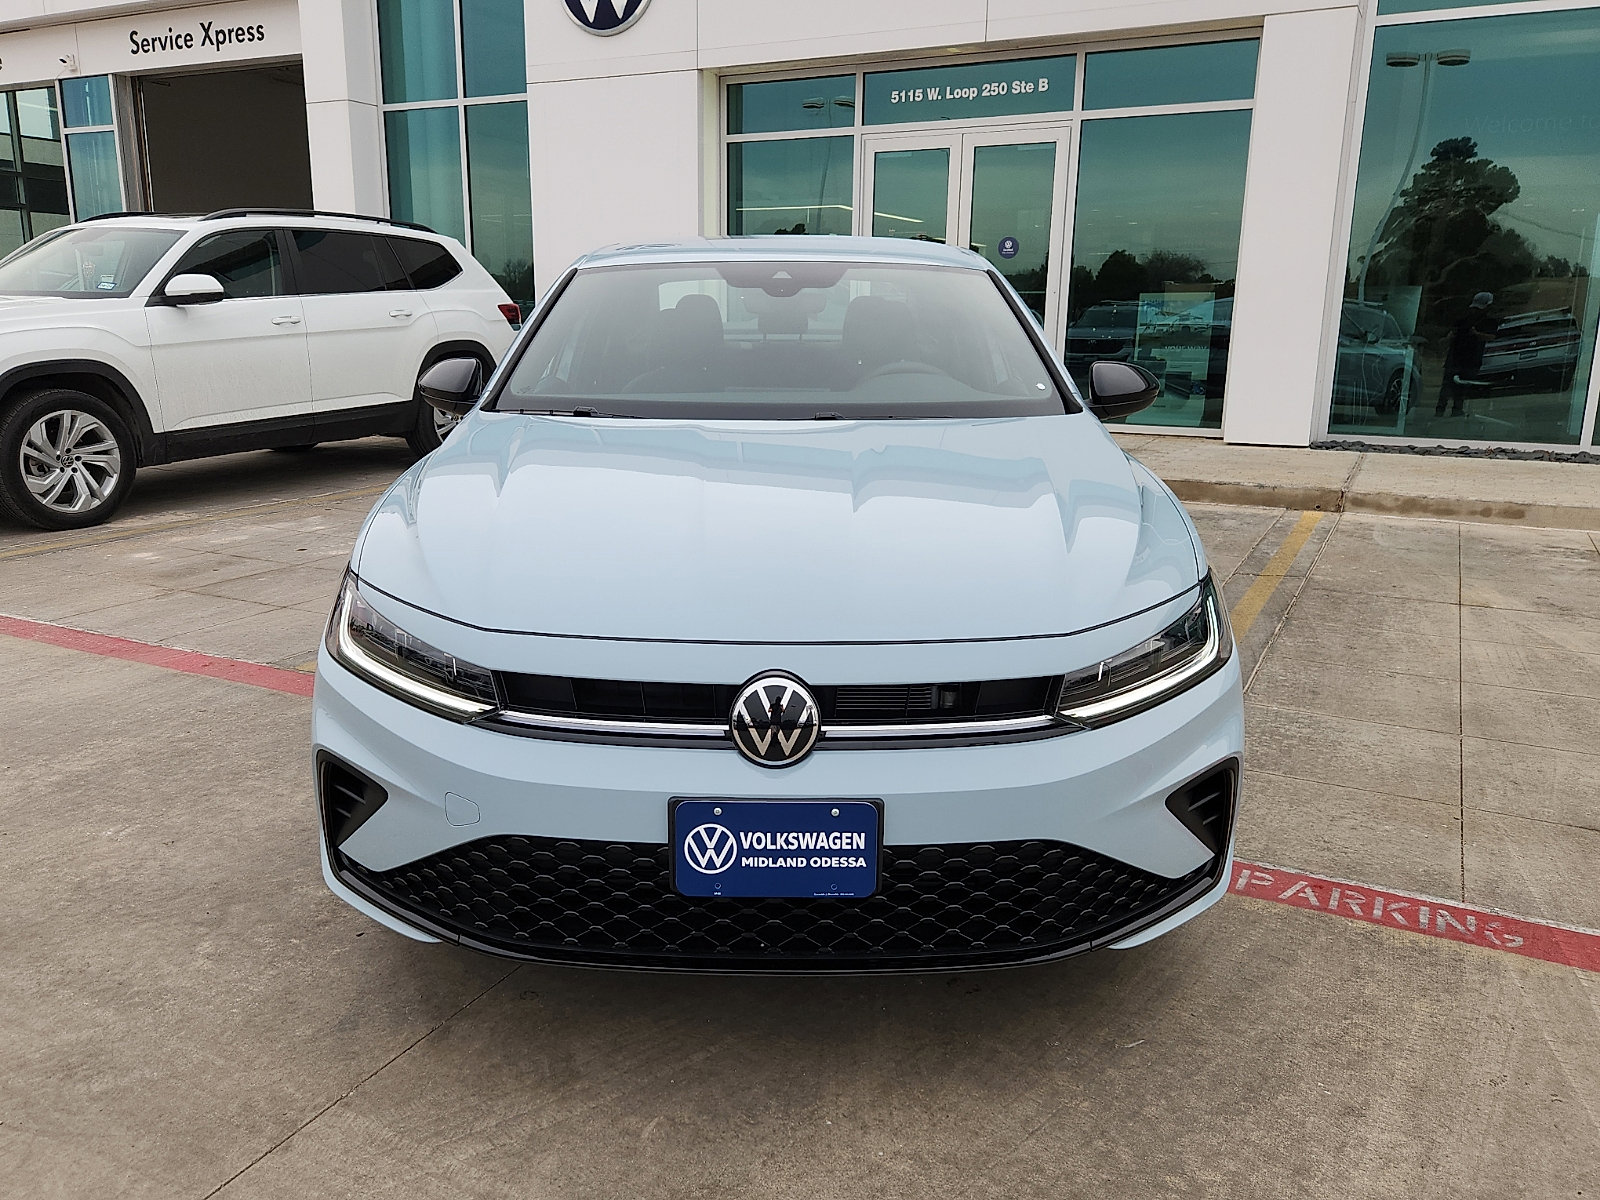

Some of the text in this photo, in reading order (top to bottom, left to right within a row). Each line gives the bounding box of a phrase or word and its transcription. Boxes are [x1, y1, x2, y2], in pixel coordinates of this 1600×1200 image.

[129, 21, 265, 55] Service Xpress
[890, 77, 1049, 103] 5115 W. Loop 250 Ste B
[685, 825, 736, 873] VW
[739, 831, 866, 850] VOLKSWAGEN
[741, 857, 867, 868] MIDLAND ODESSA
[1234, 868, 1525, 949] PARKING
